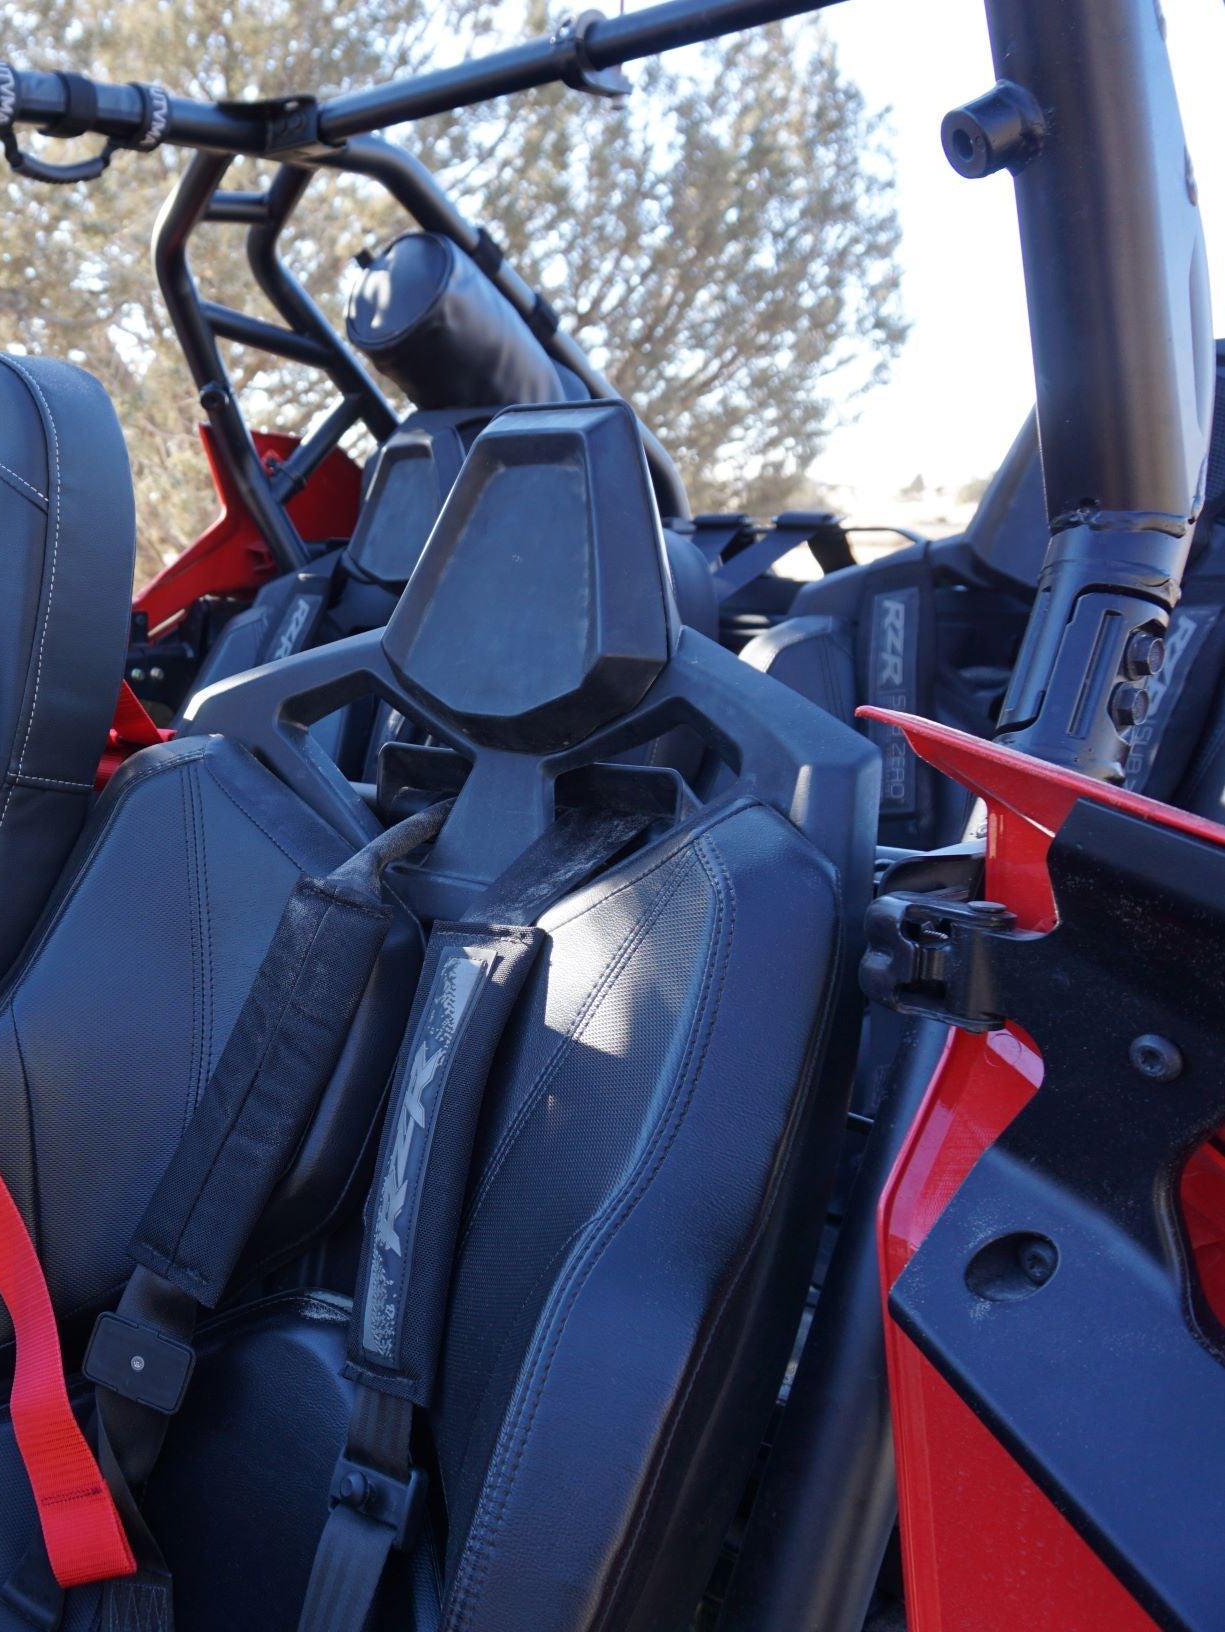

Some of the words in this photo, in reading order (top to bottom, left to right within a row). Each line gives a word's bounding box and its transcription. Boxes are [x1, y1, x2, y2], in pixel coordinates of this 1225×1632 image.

[139, 87, 168, 144] UTVMA
[880, 600, 905, 686] RZR
[890, 742, 907, 799] ZERO
